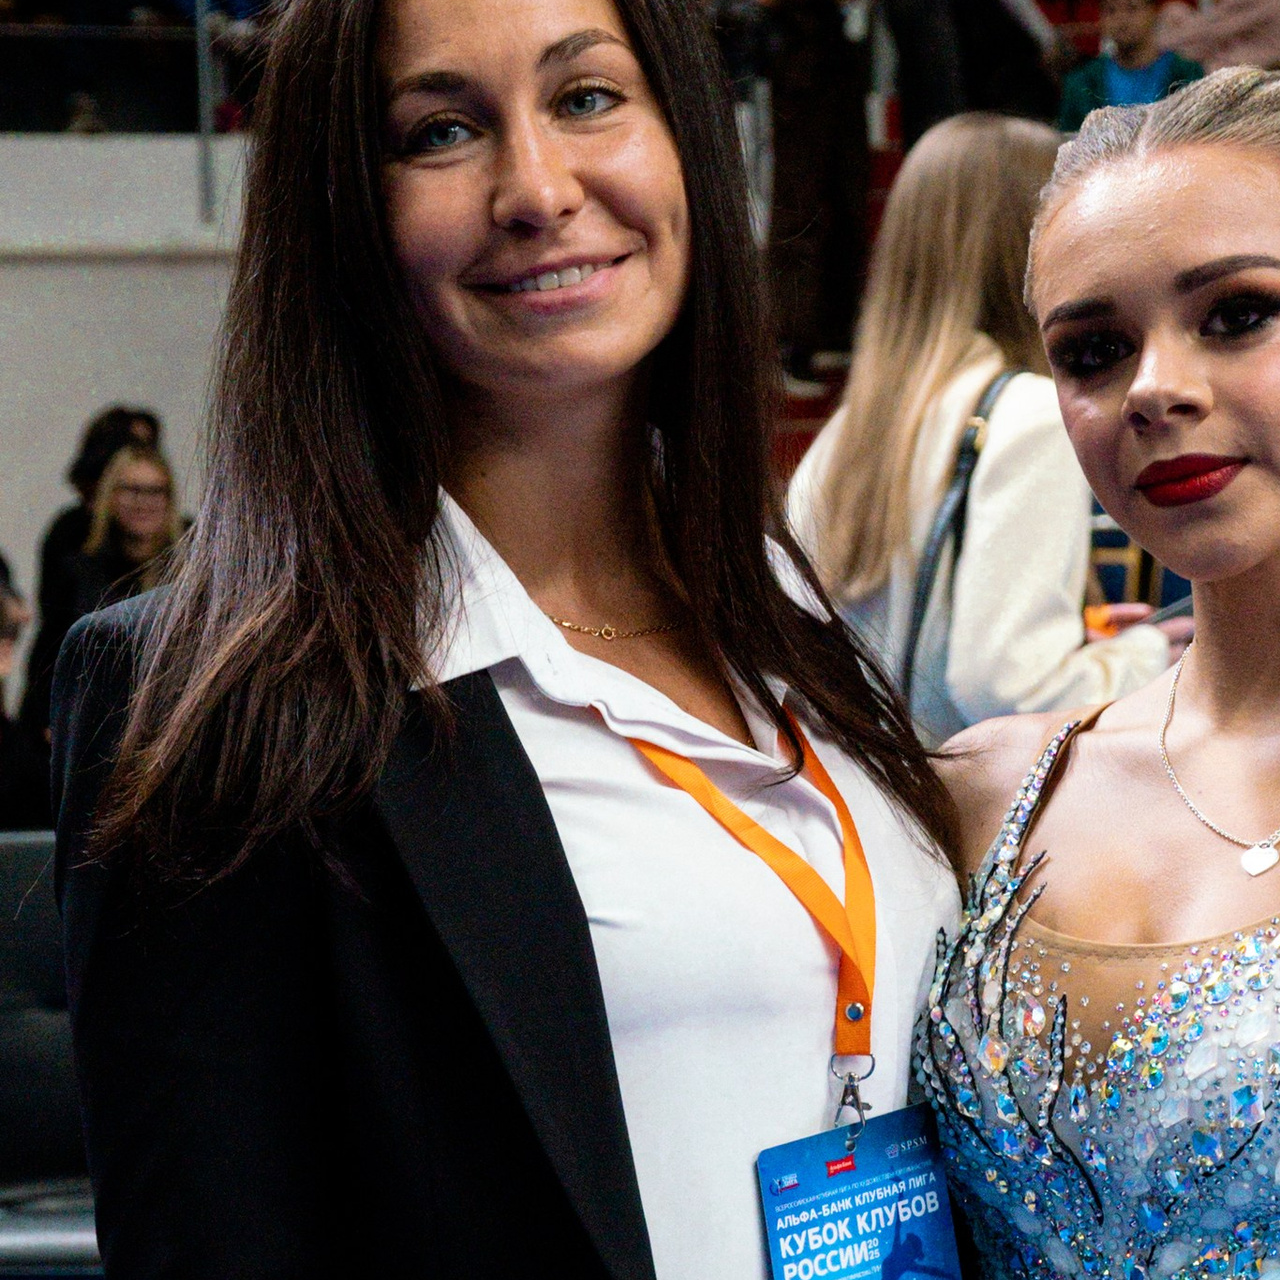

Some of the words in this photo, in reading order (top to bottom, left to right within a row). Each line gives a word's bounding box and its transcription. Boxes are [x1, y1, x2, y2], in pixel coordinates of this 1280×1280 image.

[777, 1197, 852, 1231] АЛЬФА-БАНК
[855, 1181, 906, 1206] КЛУБНАЯ
[908, 1172, 936, 1190] ЛИГА
[779, 1217, 852, 1258] КУБОК
[856, 1191, 939, 1235] КЛУБОВ
[868, 1237, 879, 1249] 20
[868, 1249, 880, 1260] 25
